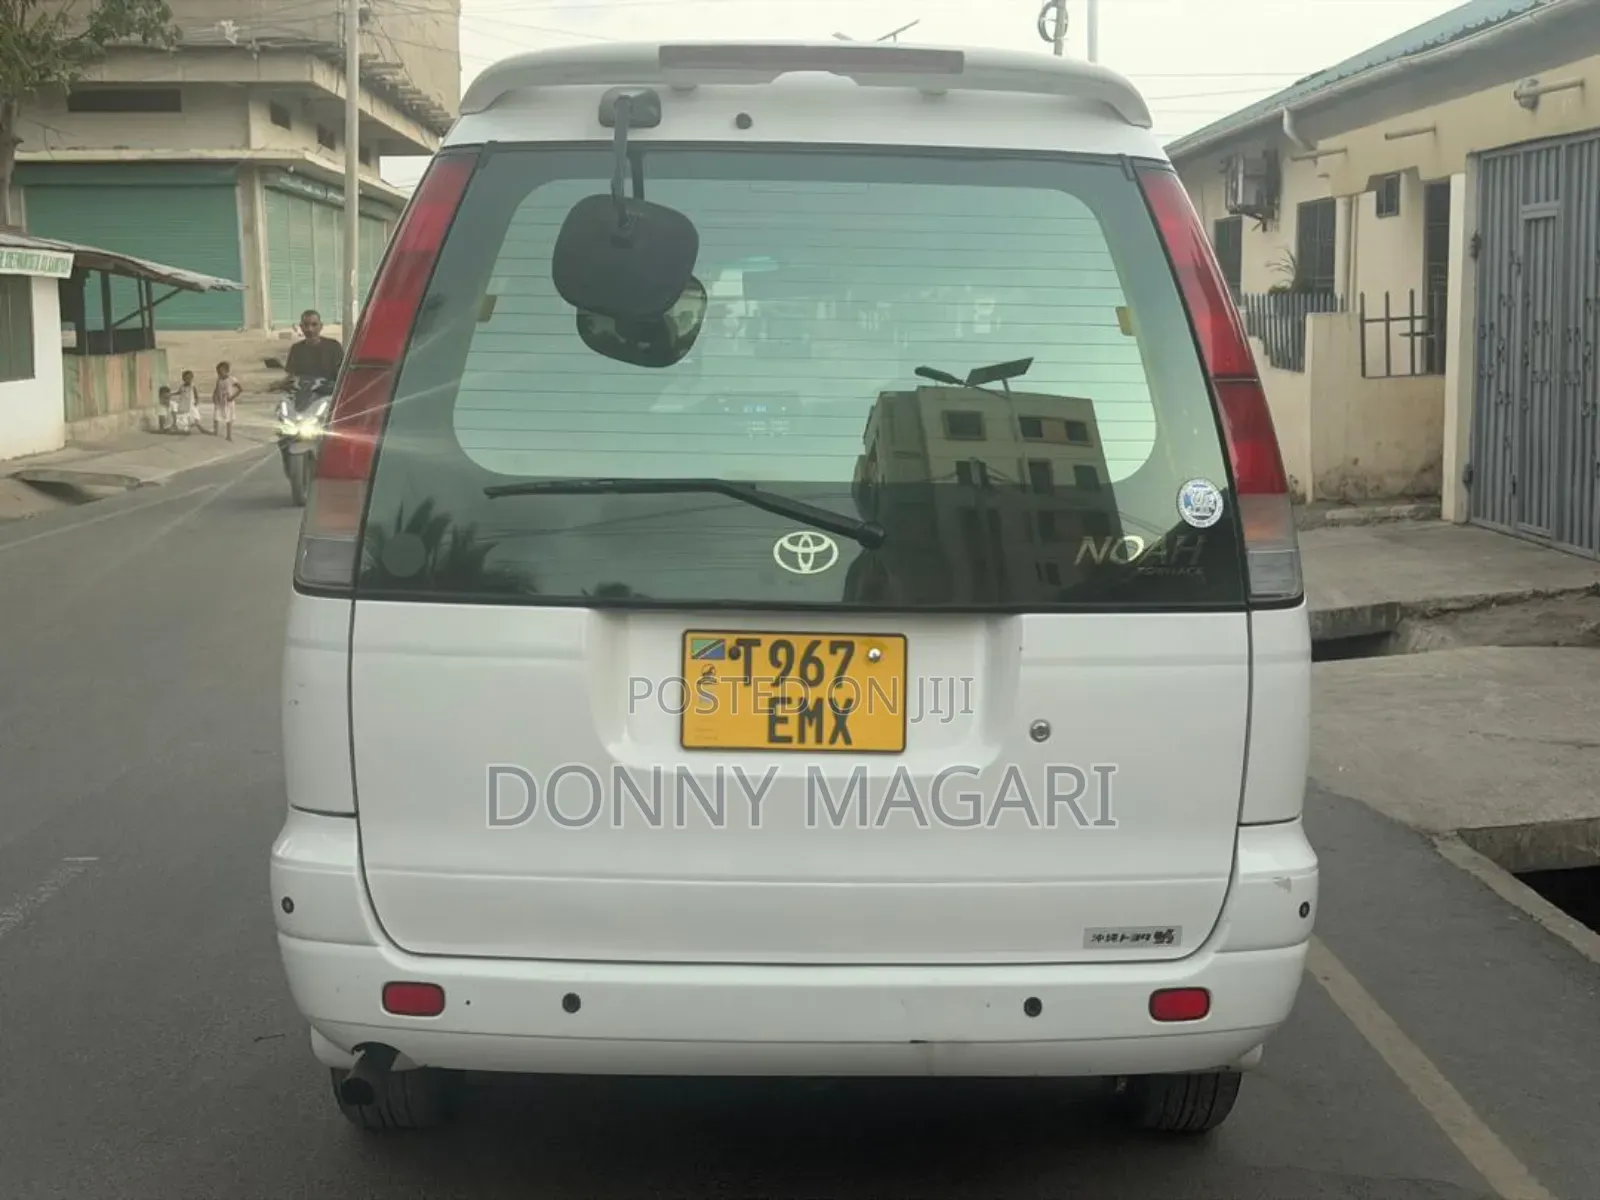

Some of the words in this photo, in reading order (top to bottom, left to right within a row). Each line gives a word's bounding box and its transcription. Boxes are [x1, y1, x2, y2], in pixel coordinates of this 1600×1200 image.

[1074, 535, 1206, 565] NOAH
[735, 638, 762, 687] T
[768, 638, 856, 689] 967
[767, 696, 854, 746] EMX
